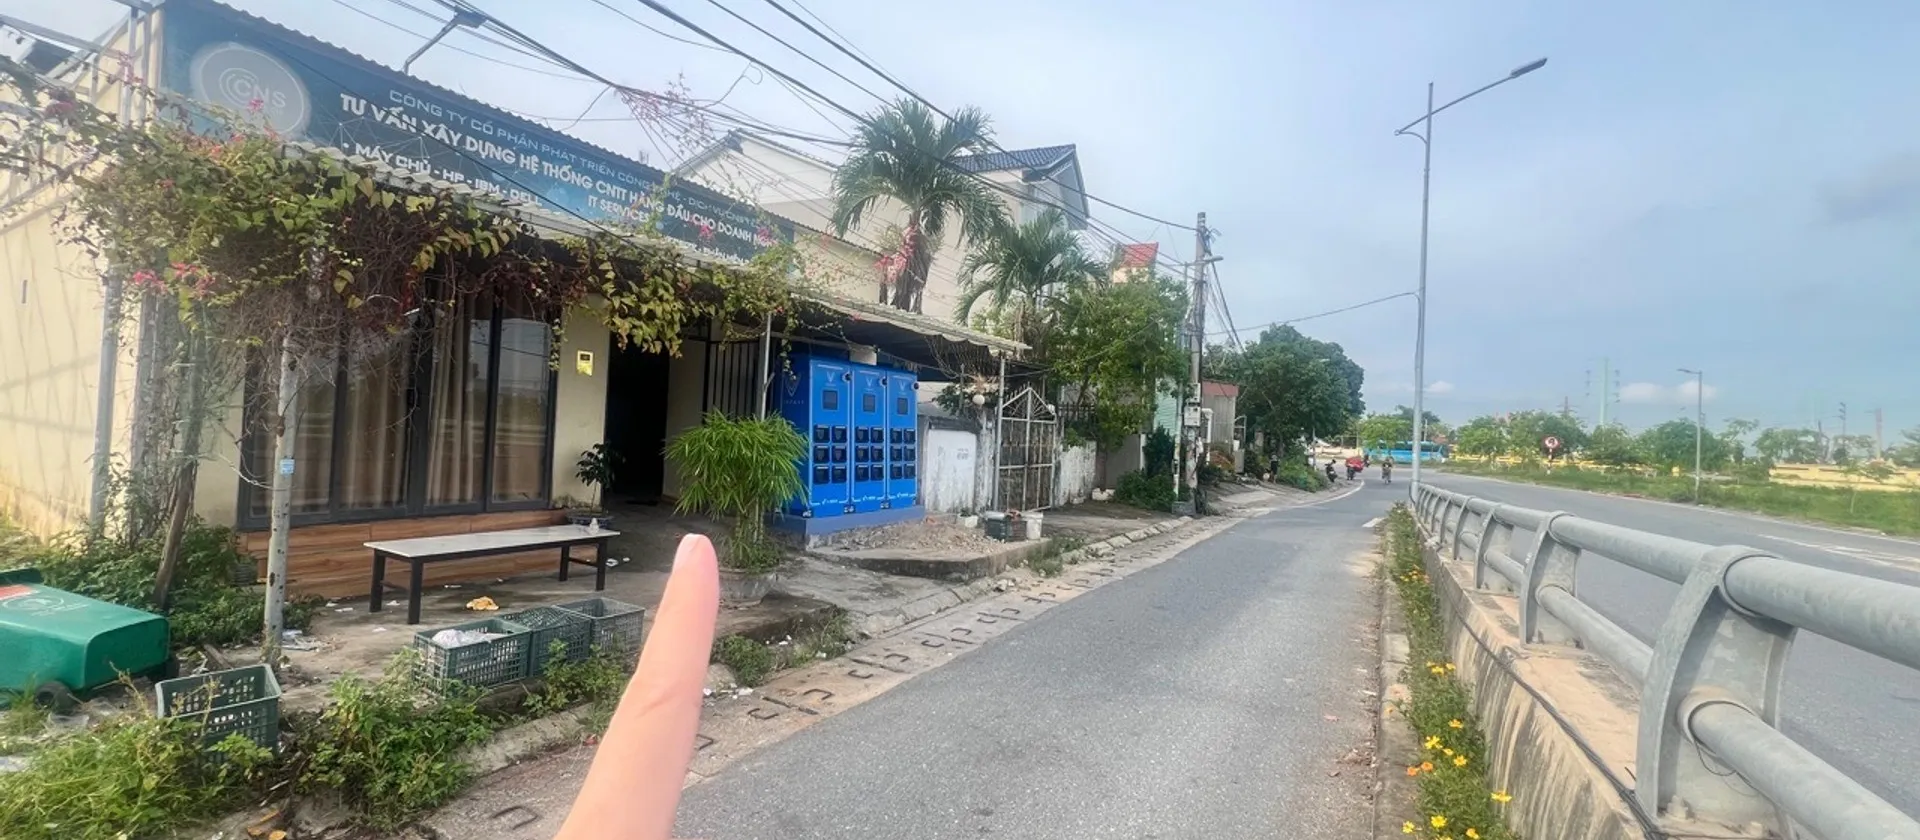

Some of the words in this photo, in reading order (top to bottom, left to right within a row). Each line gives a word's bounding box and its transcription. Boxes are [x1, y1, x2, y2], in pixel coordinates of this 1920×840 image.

[389, 89, 442, 117] CÔNG
[446, 109, 468, 125] TY
[541, 144, 577, 162] PHÁT
[355, 142, 393, 163] MÁY
[395, 156, 432, 175] CHỦ
[442, 169, 465, 183] HP
[474, 178, 500, 194] IBM
[510, 189, 542, 206] DELL
[371, 104, 417, 133] VẤN
[421, 119, 462, 147] XÂY
[465, 135, 516, 164] DỰNG
[520, 153, 540, 175] HỆ
[542, 160, 593, 190] THỐNG
[596, 180, 627, 201] CNTT
[667, 204, 690, 222] ĐẦU
[692, 213, 716, 231] CHO
[718, 221, 752, 243] DOANH
[588, 194, 598, 209] IT
[600, 199, 650, 222] SERVICES
